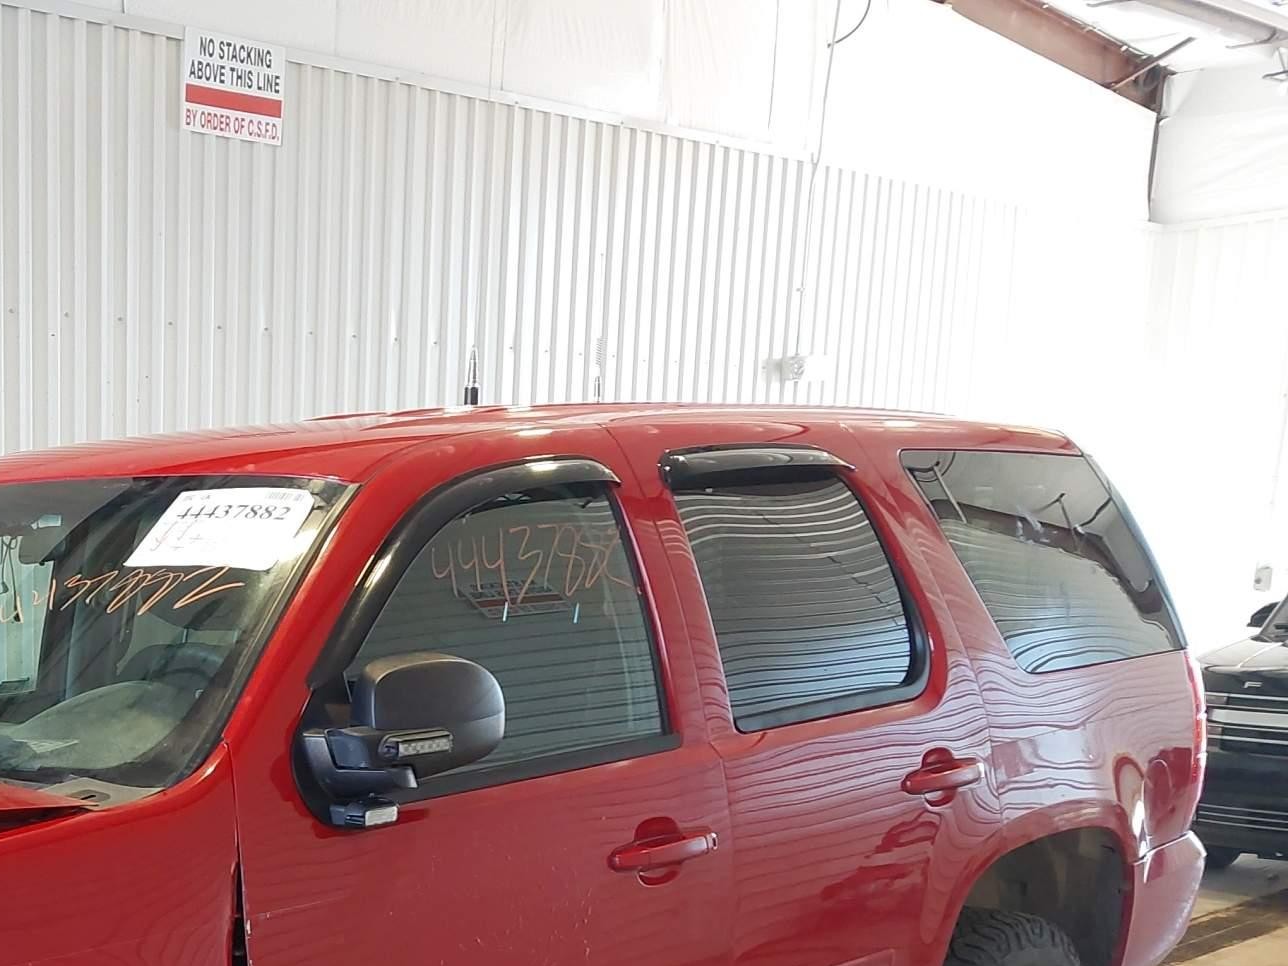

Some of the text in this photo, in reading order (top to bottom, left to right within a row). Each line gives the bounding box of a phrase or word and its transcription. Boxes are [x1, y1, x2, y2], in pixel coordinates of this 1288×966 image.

[200, 36, 272, 69] NO STACKING
[189, 60, 280, 94] ABOVE THIS LINE
[185, 108, 198, 126] BY
[200, 111, 231, 133] ORDER
[233, 117, 245, 135] OF
[176, 504, 292, 520] 44437882
